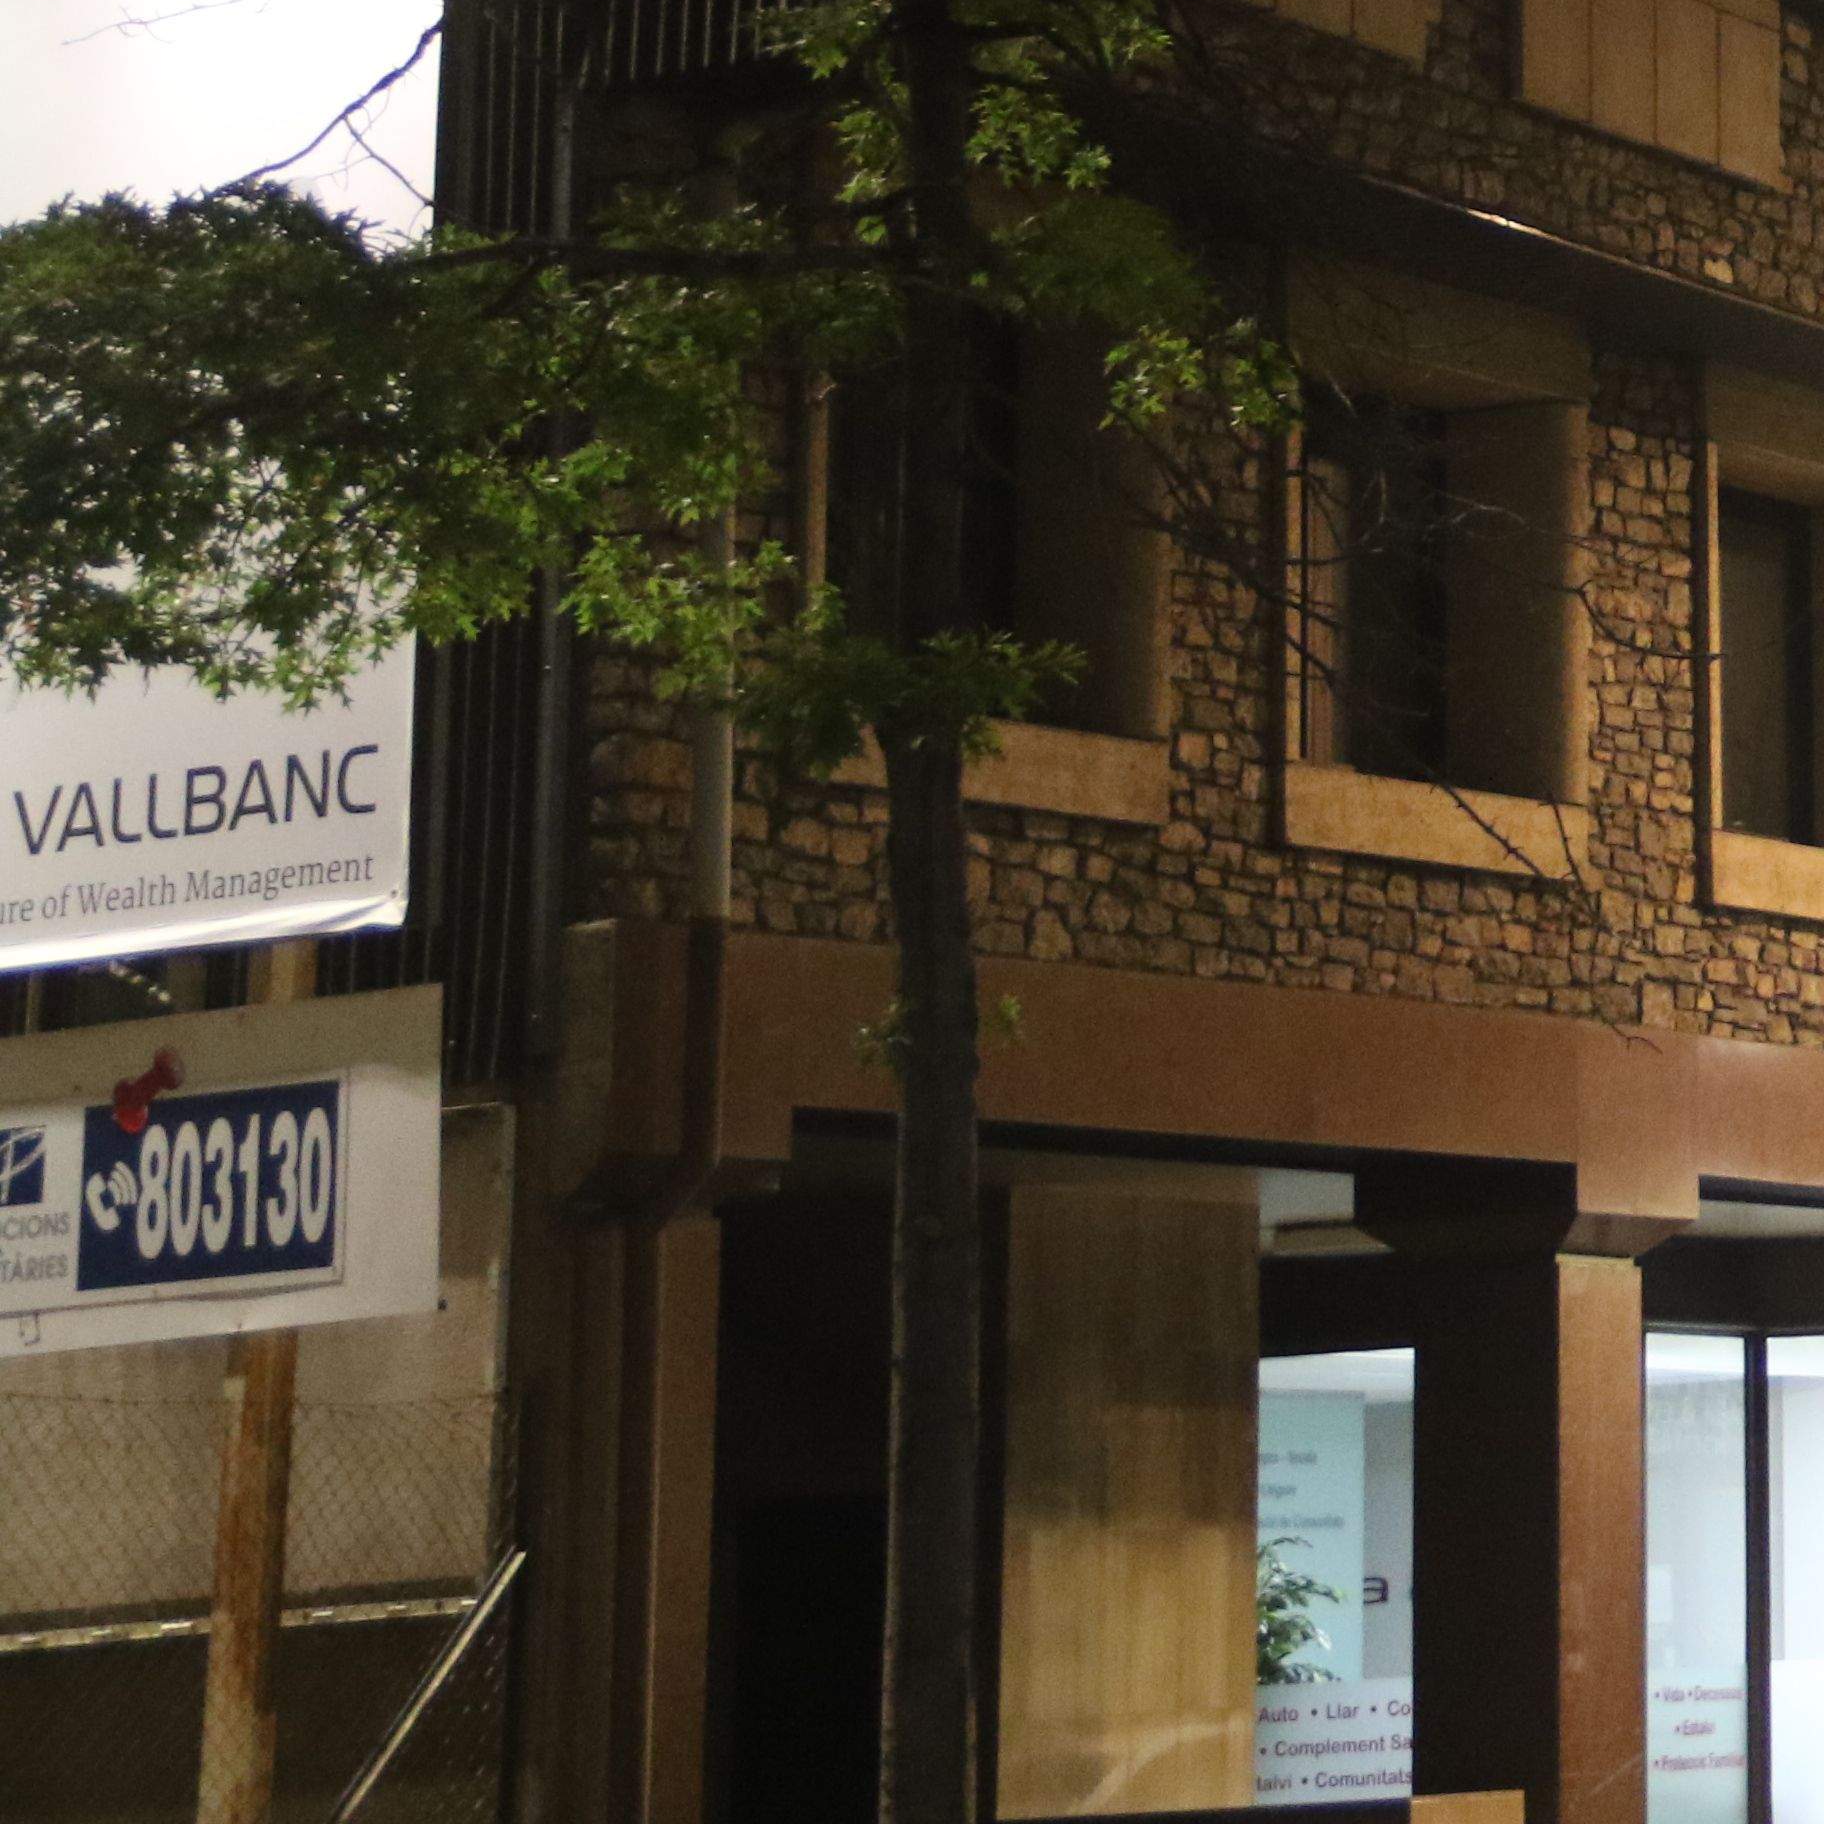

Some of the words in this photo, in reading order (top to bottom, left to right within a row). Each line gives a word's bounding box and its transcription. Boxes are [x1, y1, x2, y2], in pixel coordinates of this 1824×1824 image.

[13, 743, 379, 856] VALLBANC
[41, 882, 72, 918] of
[76, 875, 176, 916] Wealth
[184, 855, 375, 902] Management
[136, 1106, 332, 1261] 803130
[0, 1211, 71, 1241] CIONS
[1274, 1736, 1386, 1758] Complement
